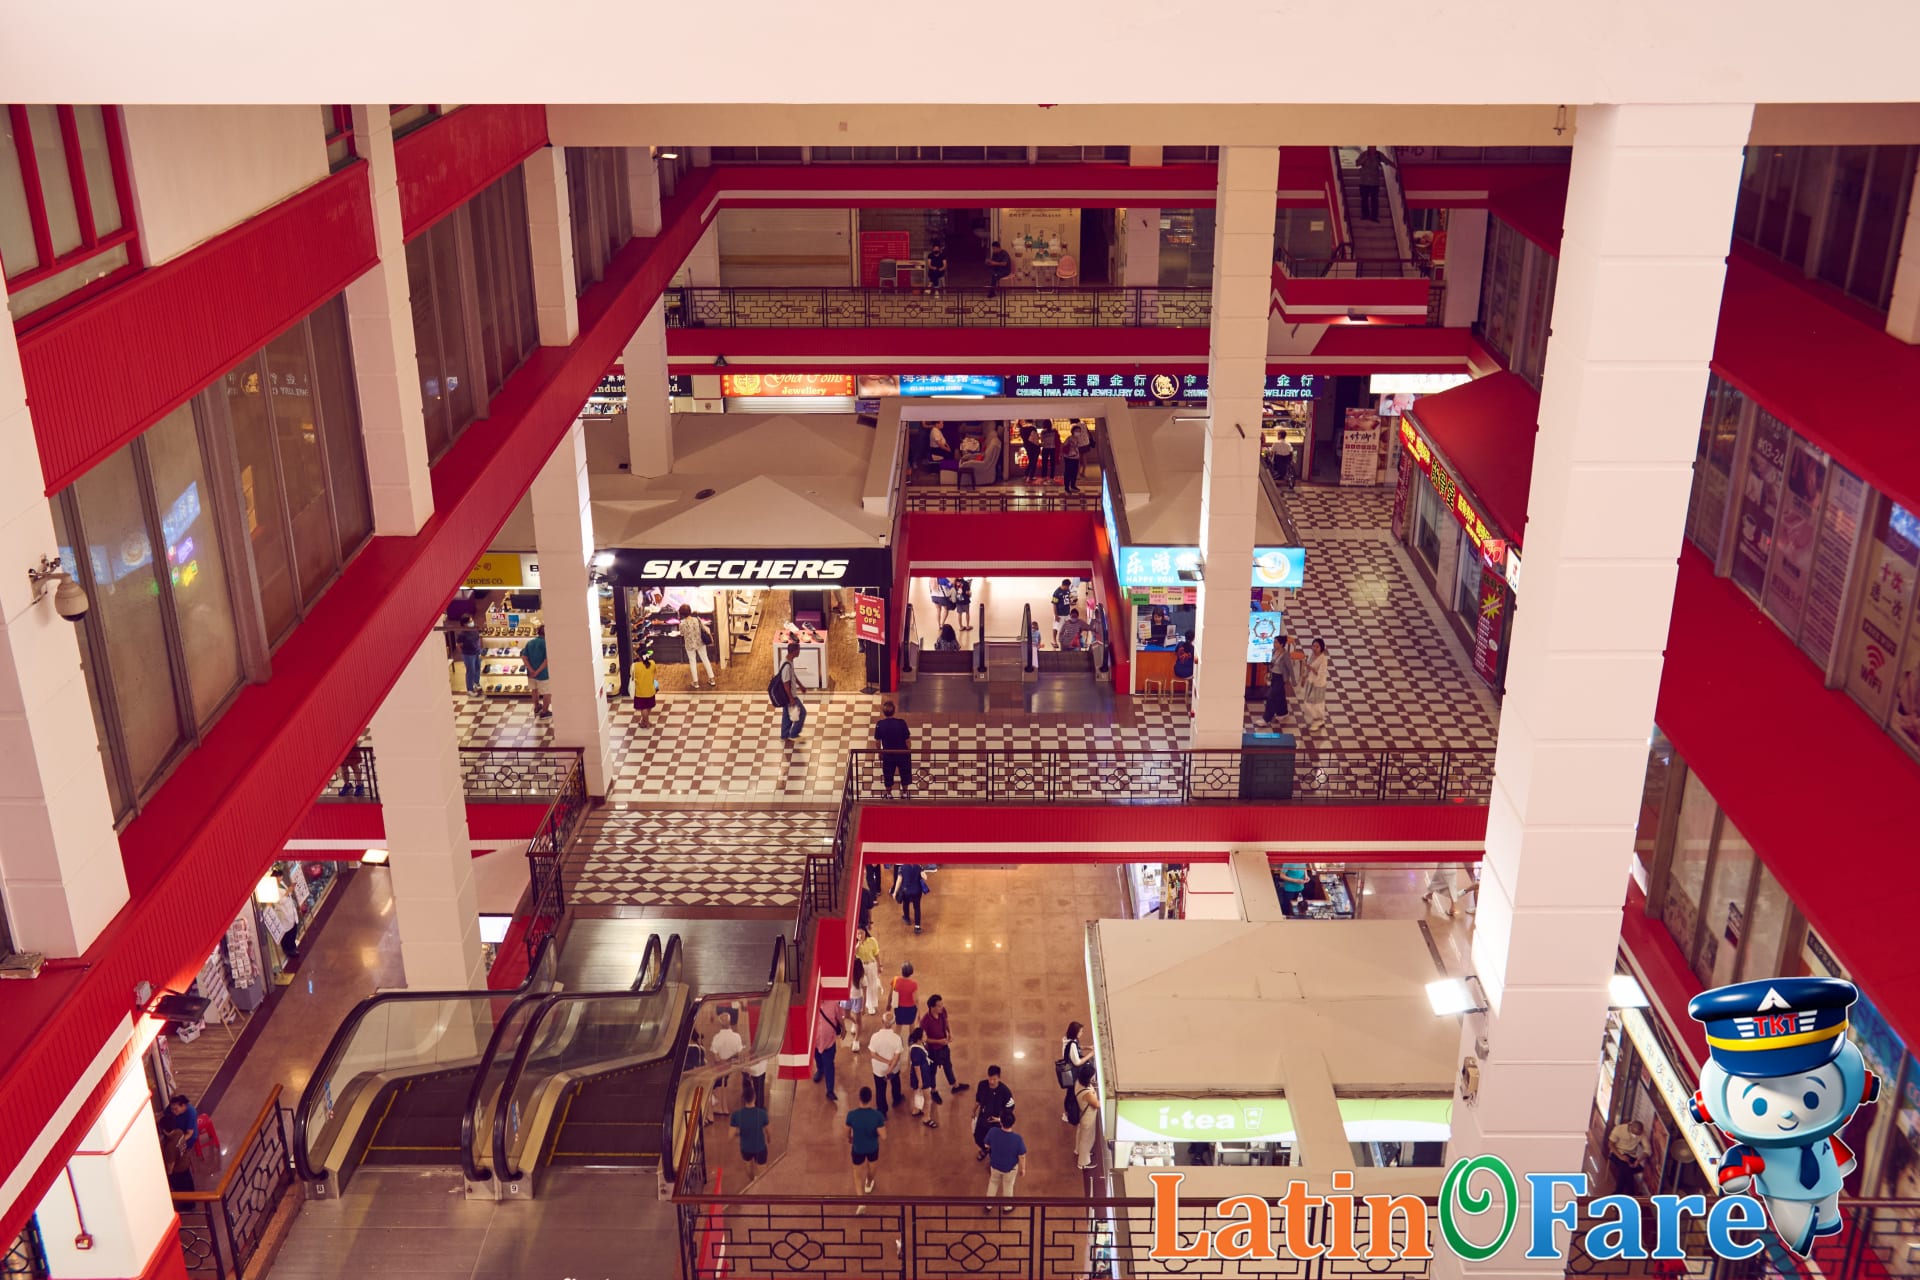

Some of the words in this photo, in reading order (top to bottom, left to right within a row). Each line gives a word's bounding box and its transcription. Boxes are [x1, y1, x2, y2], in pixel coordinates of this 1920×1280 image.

[781, 387, 826, 395] Jewellery
[1016, 388, 1042, 397] CHUNG
[1043, 388, 1061, 397] HWA
[1062, 388, 1081, 397] JADE
[1082, 388, 1088, 397] &
[1090, 388, 1133, 397] JEWELLERY
[1134, 388, 1147, 397] CO.
[1300, 389, 1313, 398] CO.
[640, 559, 849, 579] SKECHERS
[859, 605, 881, 619] 50%
[864, 616, 877, 624] OFF
